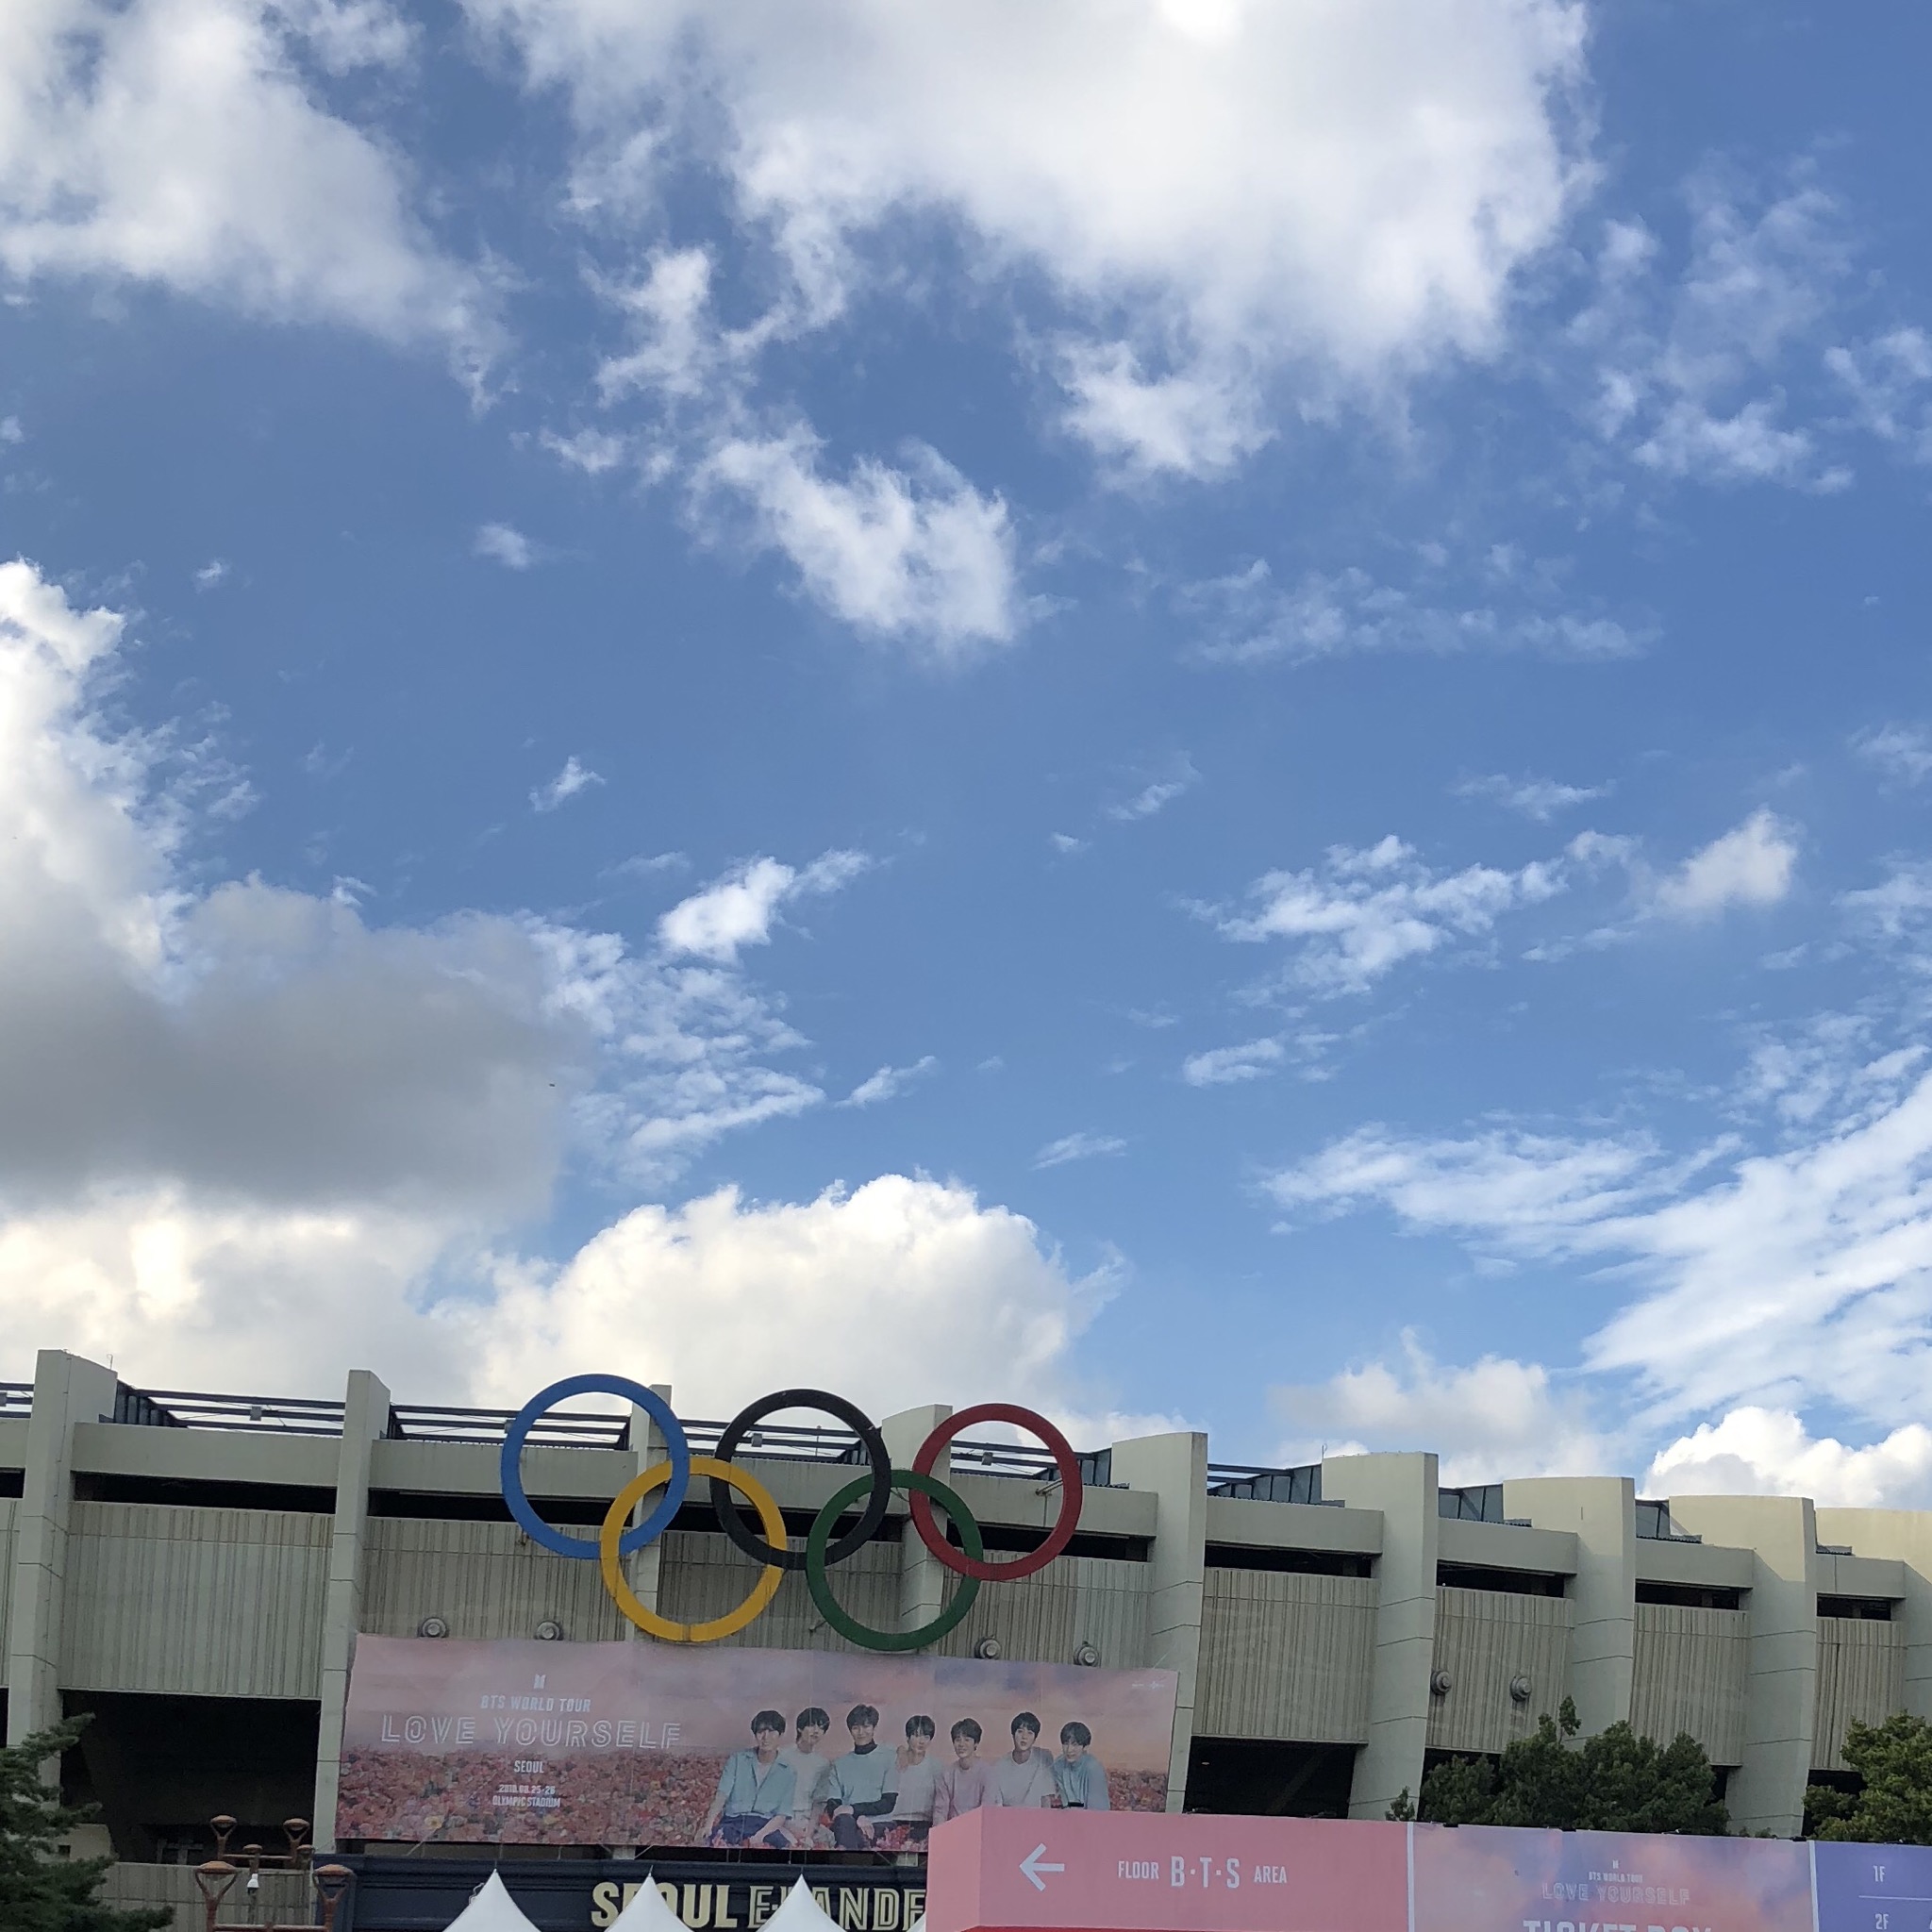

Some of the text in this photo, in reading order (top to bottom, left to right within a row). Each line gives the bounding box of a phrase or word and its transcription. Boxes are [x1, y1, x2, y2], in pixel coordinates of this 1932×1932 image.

[480, 1694, 591, 1712] BTS WORLD TOUR
[381, 1714, 681, 1749] LOVE YOURSELF
[513, 1759, 544, 1774] SEOUL
[492, 1795, 561, 1808] OLYMPIC STADIUM
[1118, 1860, 1159, 1879] FLOOR
[1254, 1865, 1288, 1884] AREA
[1873, 1864, 1886, 1882] 1F
[1541, 1882, 1690, 1906] LOVE YOURSELF
[1874, 1913, 1890, 1930] 2F
